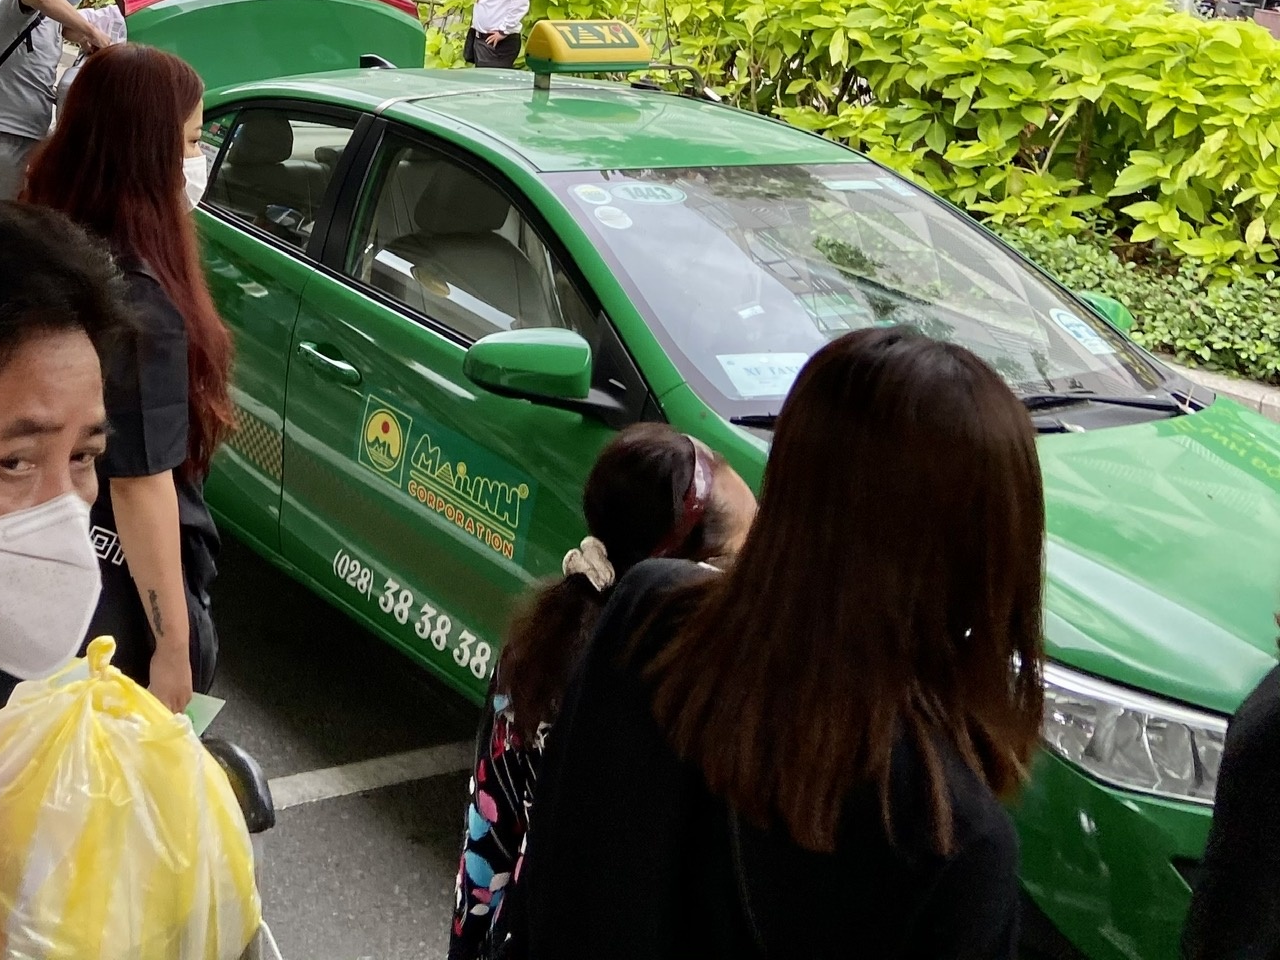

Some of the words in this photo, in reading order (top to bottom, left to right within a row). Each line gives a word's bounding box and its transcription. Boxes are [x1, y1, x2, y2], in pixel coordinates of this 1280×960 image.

[621, 186, 673, 200] 1443
[407, 479, 514, 560] CORPORATION
[333, 547, 375, 601] (028)
[378, 576, 415, 625] 38
[414, 602, 452, 652] 38
[452, 628, 492, 680] 38
